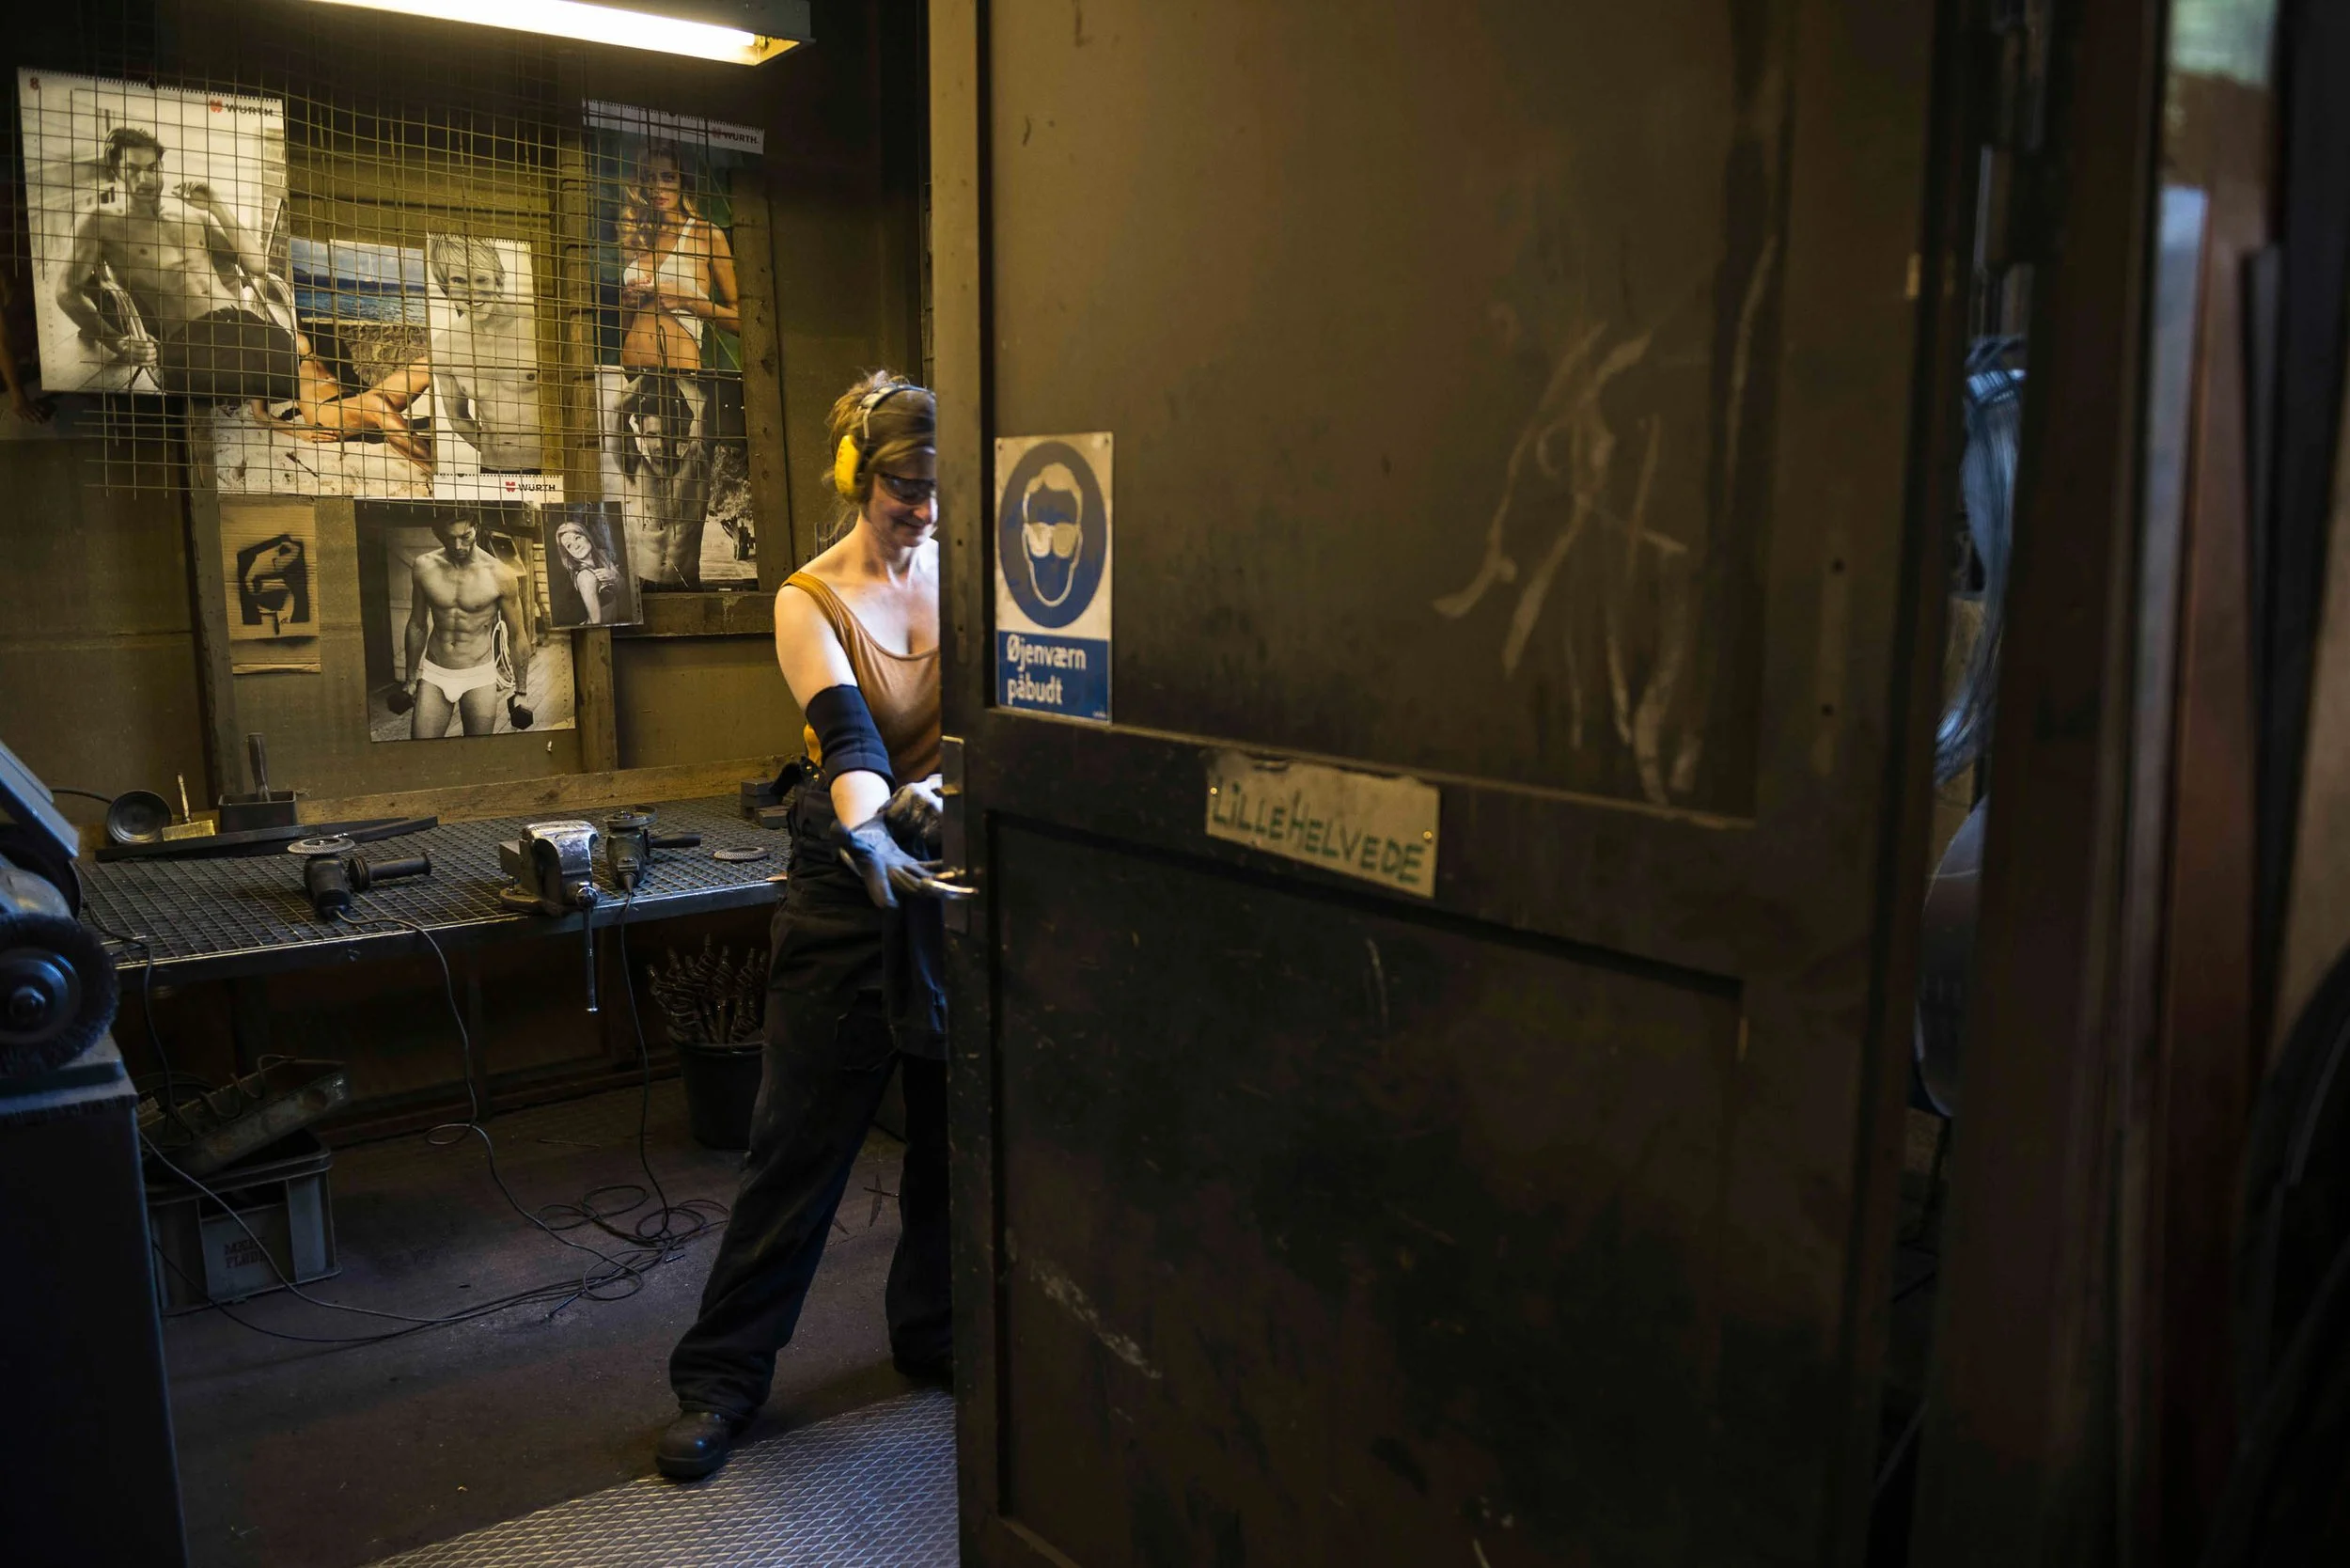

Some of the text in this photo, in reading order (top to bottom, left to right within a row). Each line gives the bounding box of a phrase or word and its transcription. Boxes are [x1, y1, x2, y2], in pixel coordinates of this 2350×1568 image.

[518, 483, 556, 492] WÜRTH
[1007, 634, 1087, 671] Øjenværn
[1007, 672, 1063, 705] påbudt
